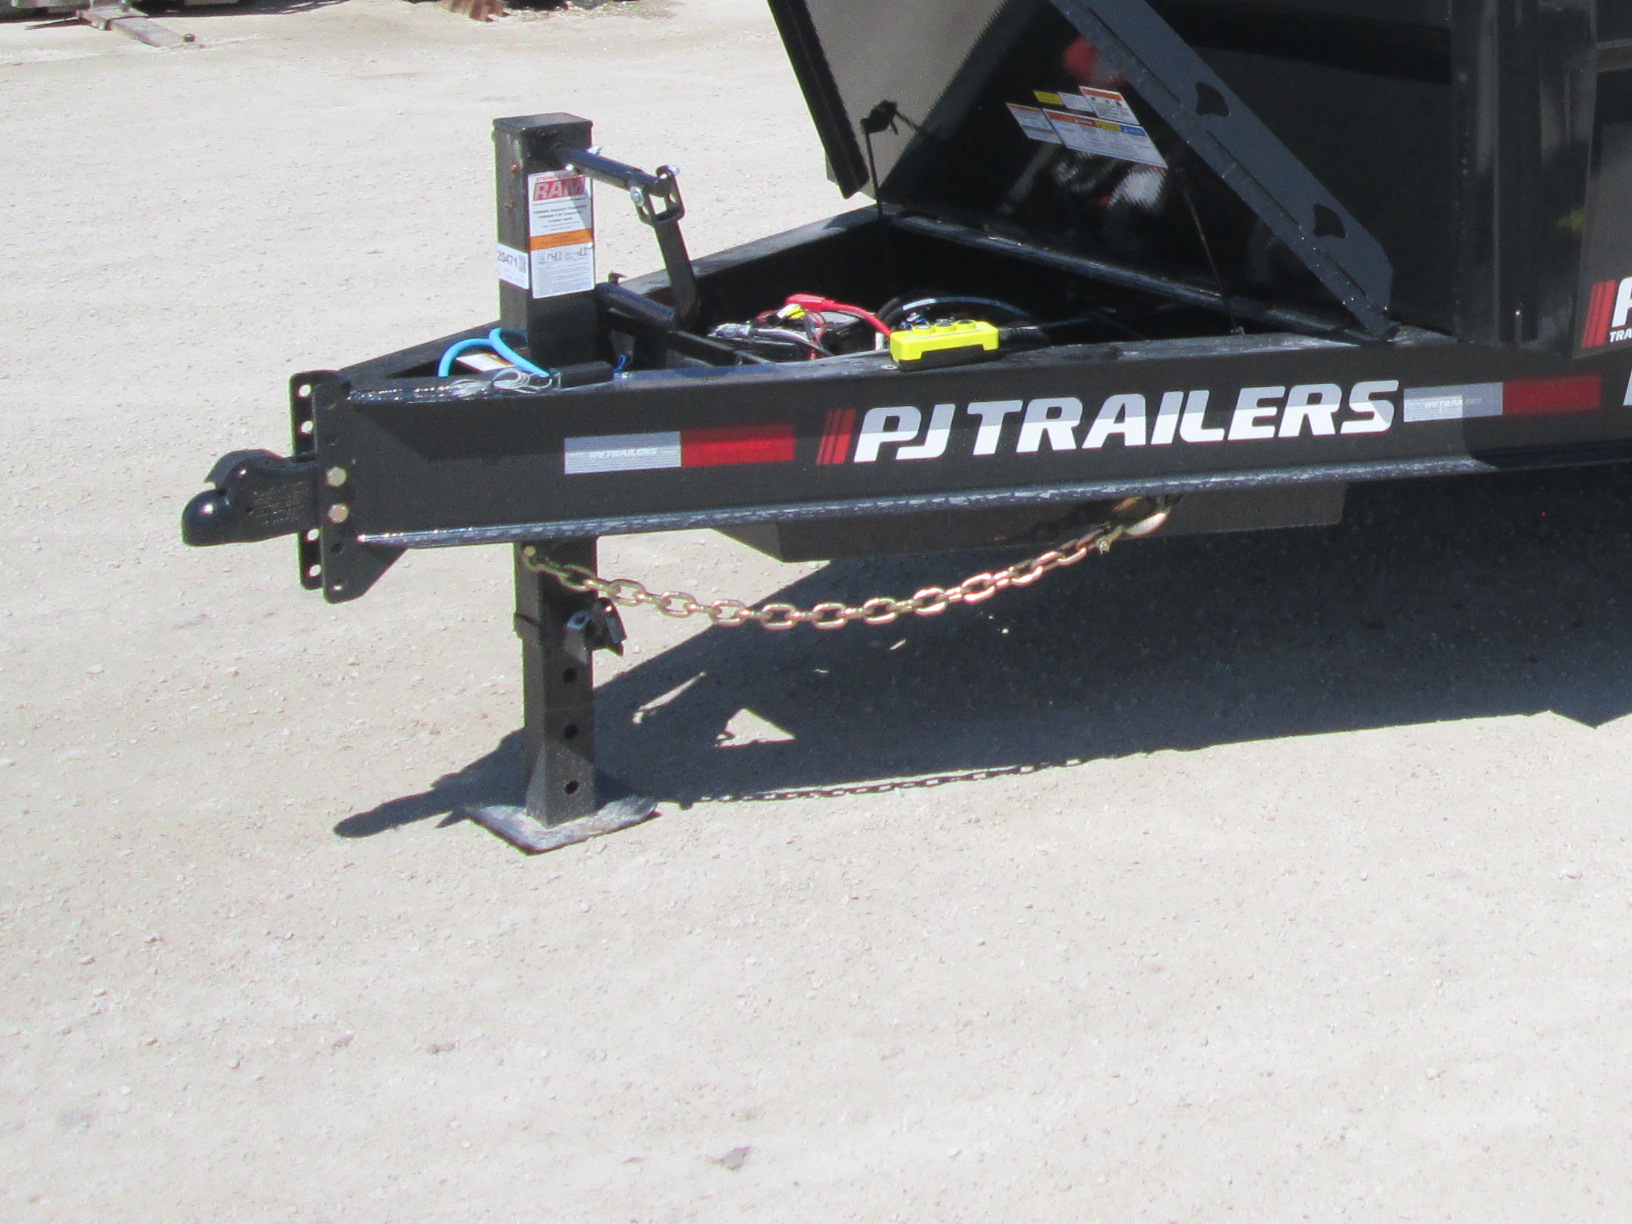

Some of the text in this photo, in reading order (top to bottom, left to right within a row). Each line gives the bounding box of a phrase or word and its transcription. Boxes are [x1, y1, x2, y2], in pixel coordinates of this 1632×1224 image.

[534, 178, 584, 201] RAM
[853, 379, 1399, 463] PJ TRAILERS
